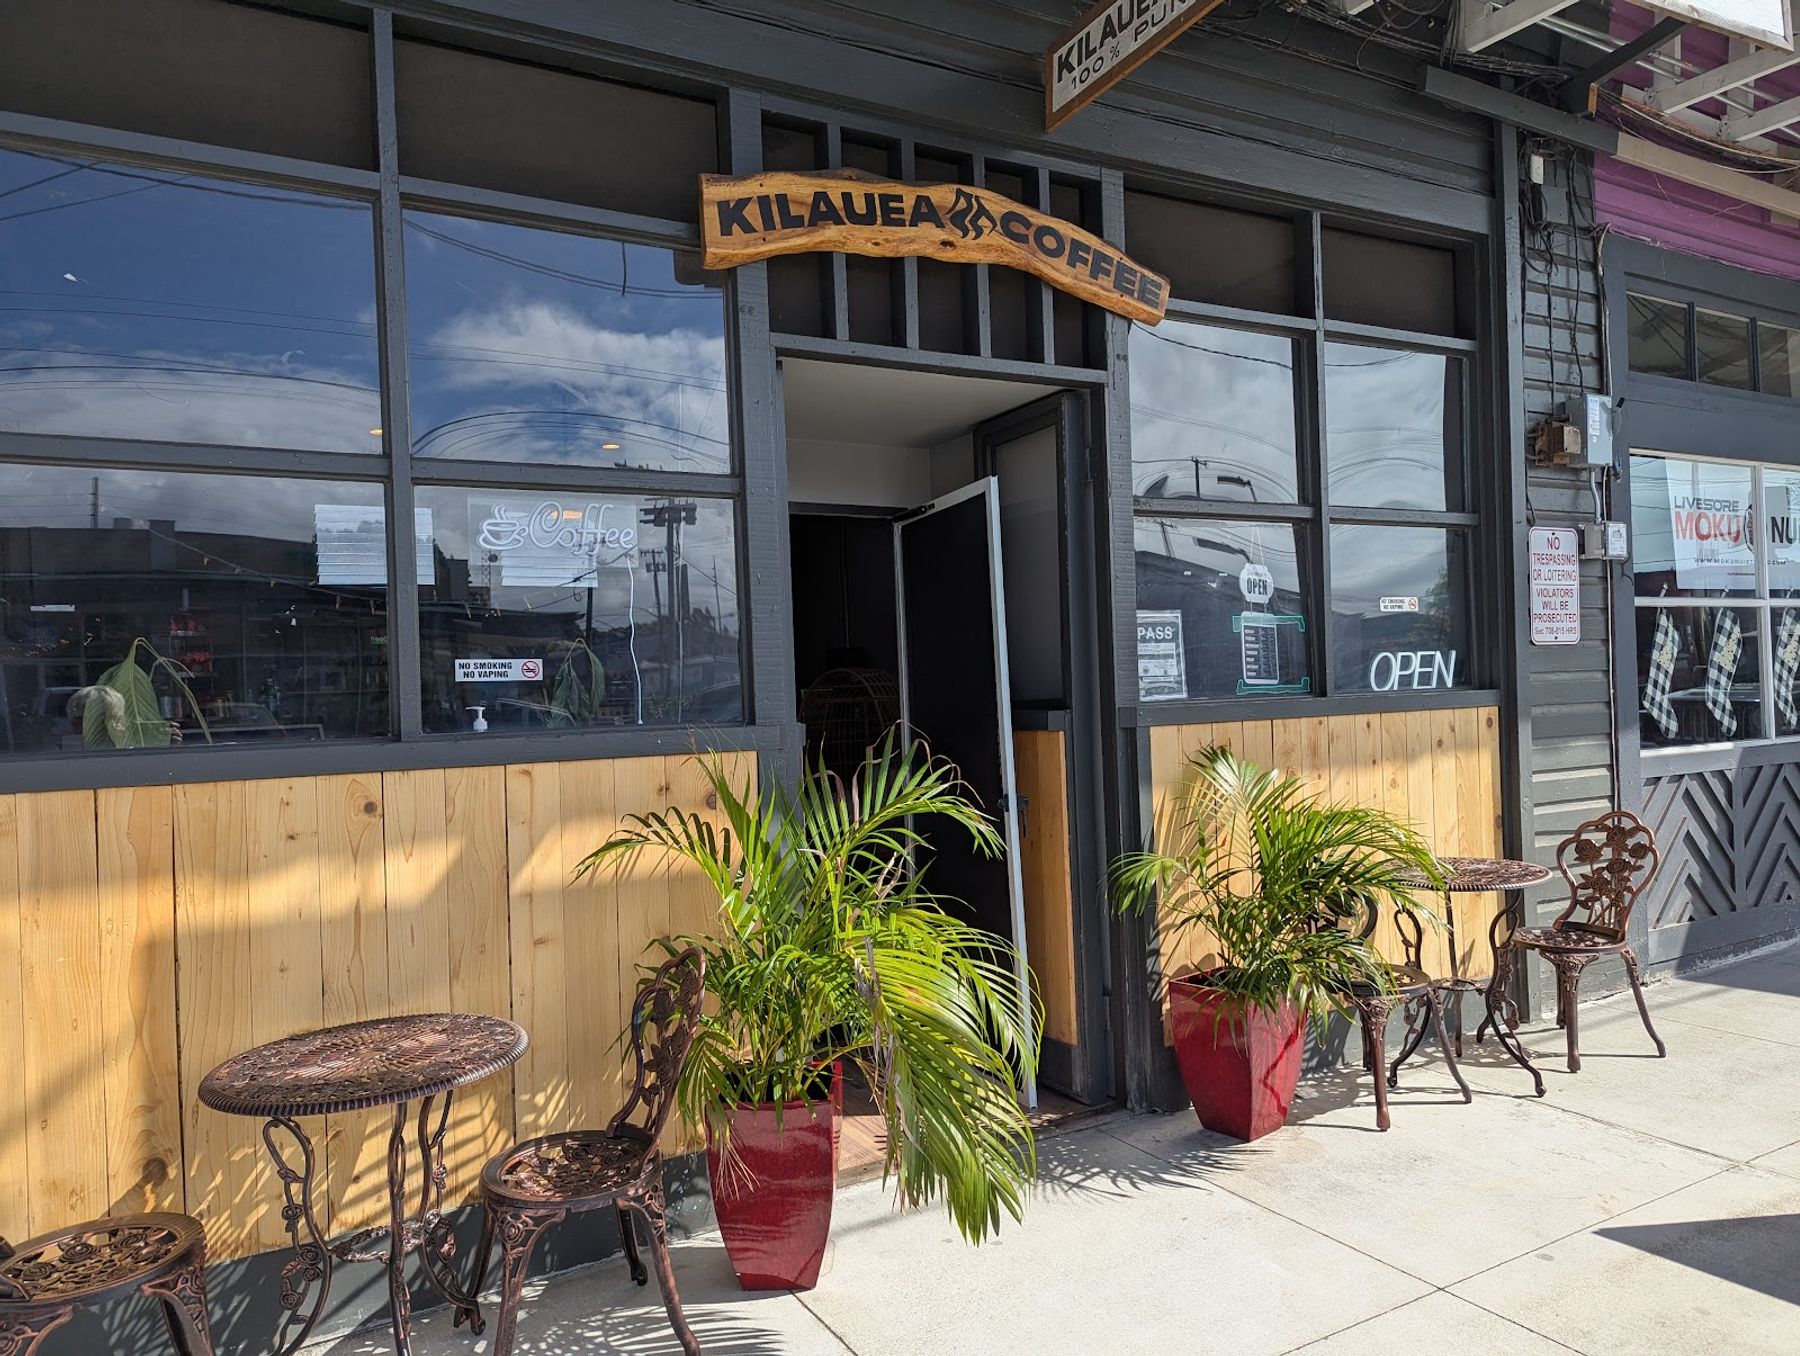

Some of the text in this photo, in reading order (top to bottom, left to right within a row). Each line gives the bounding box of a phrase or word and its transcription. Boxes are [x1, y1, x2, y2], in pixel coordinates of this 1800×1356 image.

[717, 191, 1164, 309] KILAUEA COFFEE
[529, 501, 634, 556] Coffee
[1674, 511, 1741, 543] MOKU
[1770, 516, 1800, 545] NU
[1547, 537, 1560, 551] NO
[1533, 553, 1576, 566] TRESPASSING
[1533, 569, 1576, 581] OR LOITERING
[1246, 577, 1268, 595] OPEN
[1536, 588, 1574, 598] VIOLATORS
[1542, 601, 1569, 610] WILL BE
[1533, 613, 1576, 623] PROSECUTED
[1137, 626, 1173, 640] PASS
[1566, 627, 1577, 635] HRS
[1369, 649, 1457, 692] OPEN
